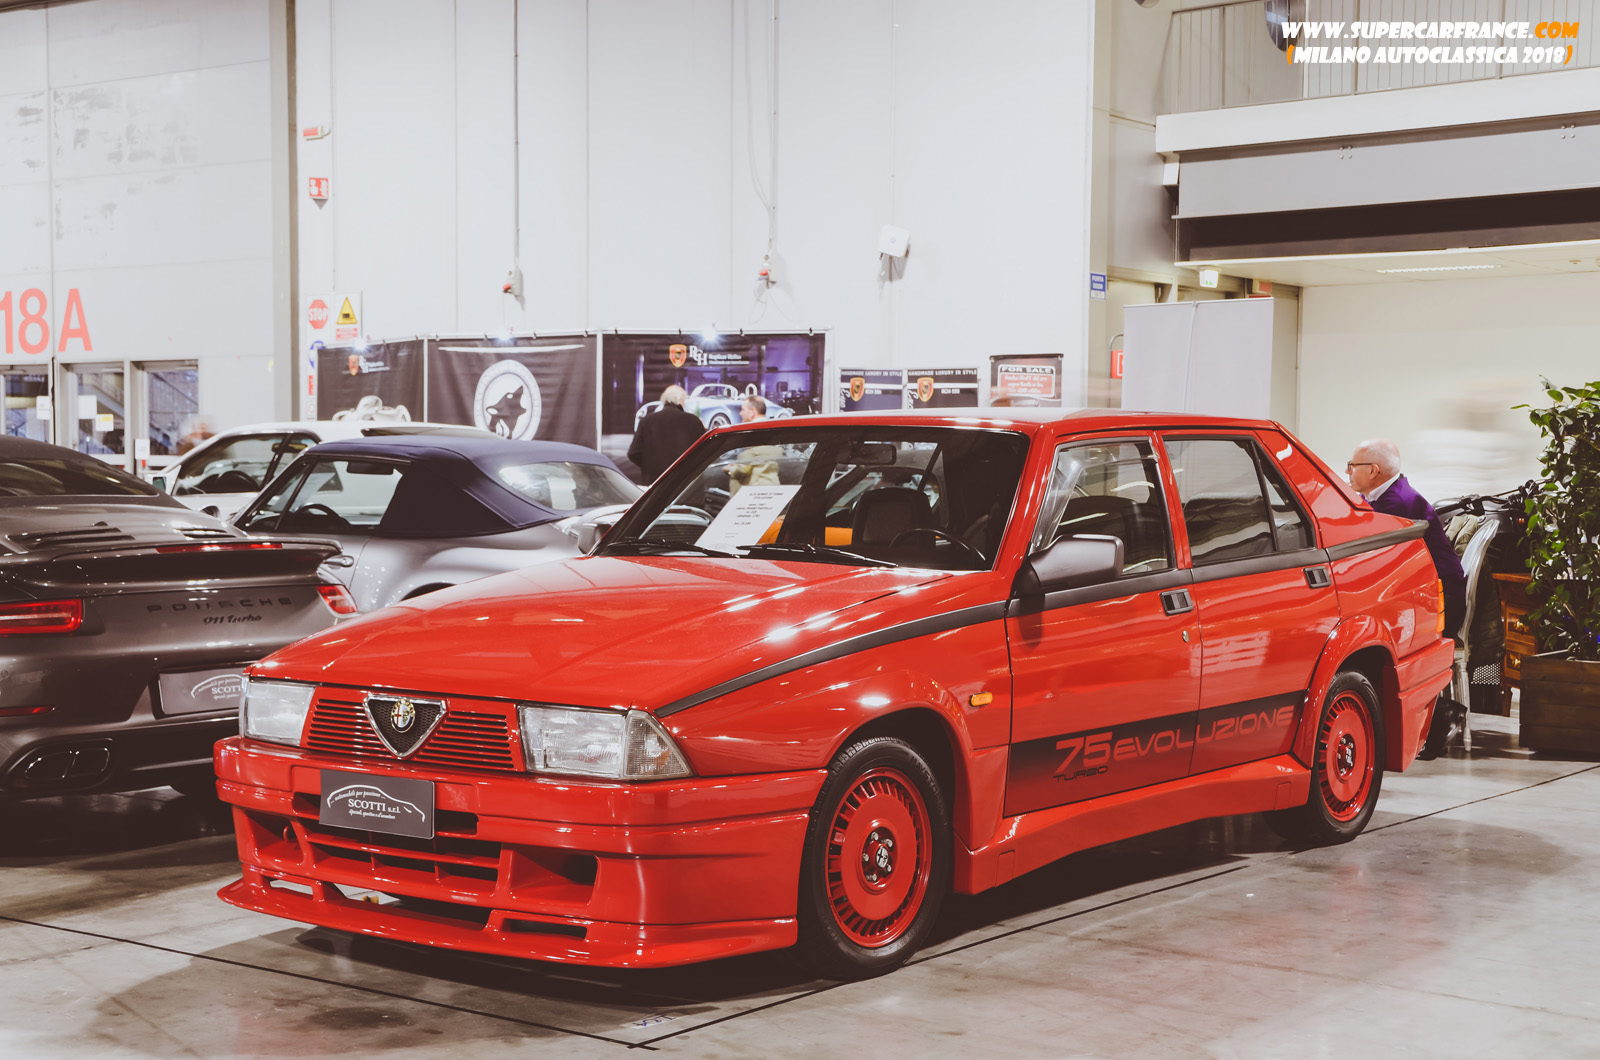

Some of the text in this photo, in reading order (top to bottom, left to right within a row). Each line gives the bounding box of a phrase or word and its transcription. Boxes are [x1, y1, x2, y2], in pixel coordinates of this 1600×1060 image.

[308, 307, 328, 321] STOP
[146, 597, 293, 613] PORSCHE
[203, 613, 262, 625] 911 Turbo
[211, 685, 241, 695] SCOTT
[1055, 705, 1295, 774] 75 EVOLUZIONE
[1053, 765, 1109, 783] TURBO
[348, 798, 386, 812] SCOTTI
